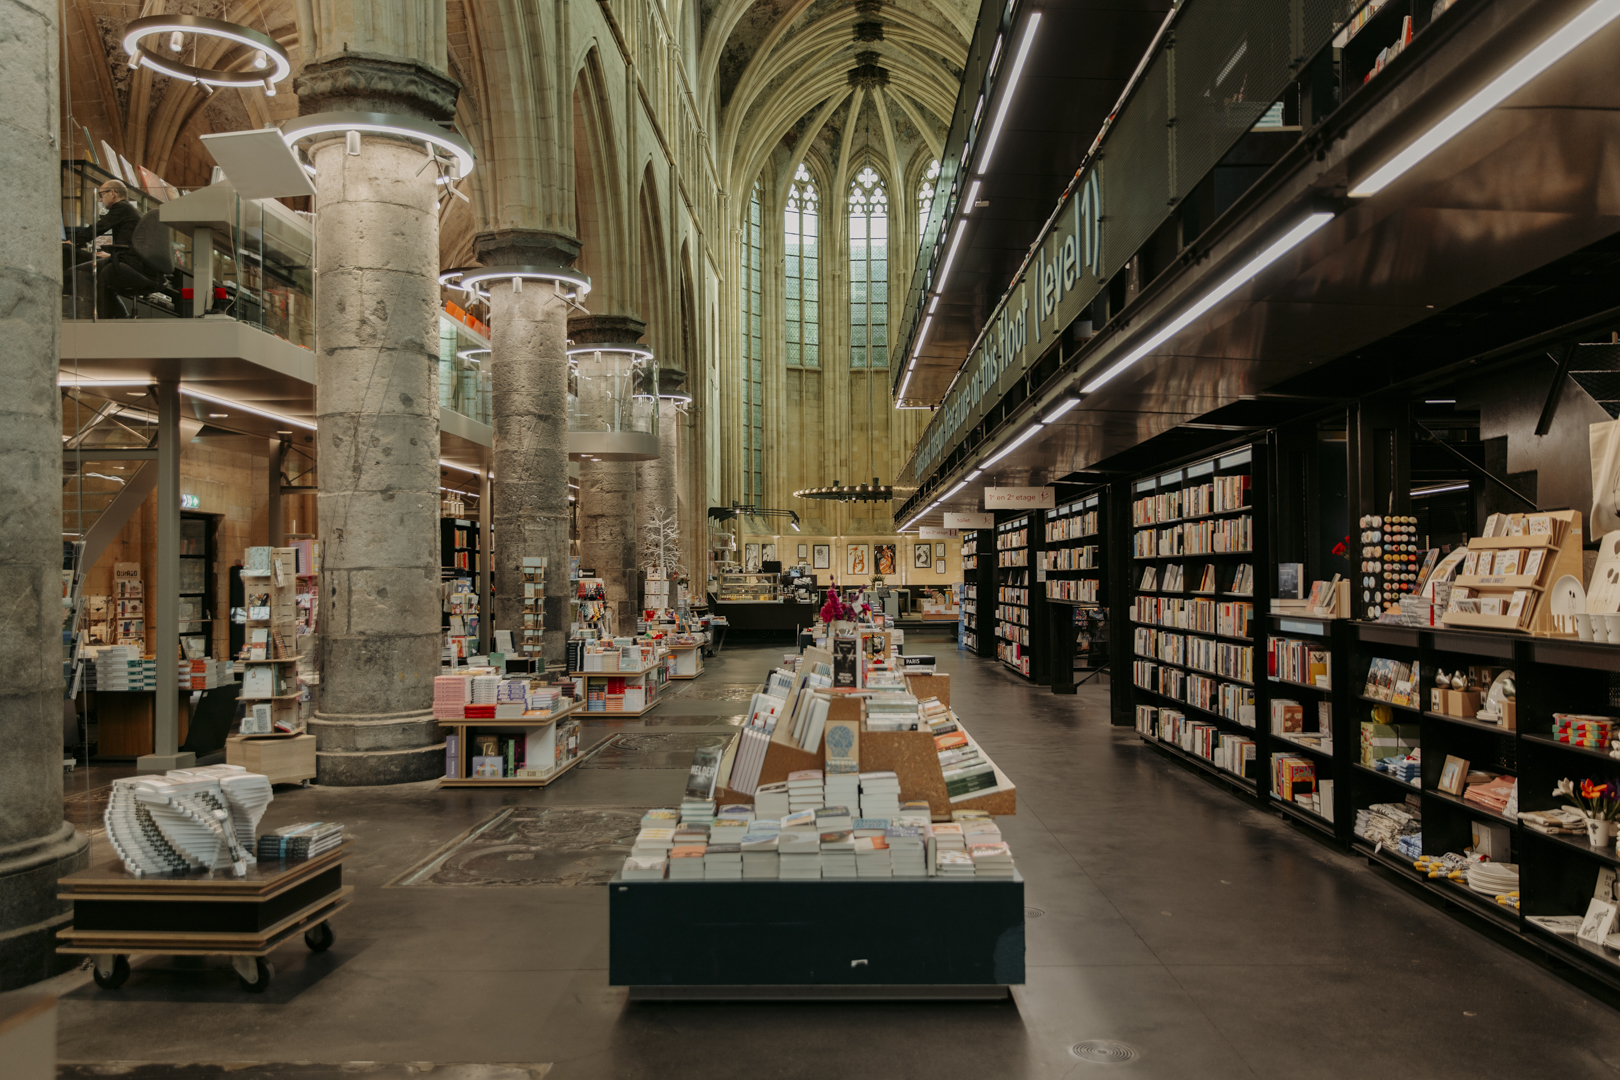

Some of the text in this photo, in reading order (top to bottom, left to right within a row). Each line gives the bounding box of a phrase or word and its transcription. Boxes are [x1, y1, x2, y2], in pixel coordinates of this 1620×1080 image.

[971, 370, 980, 409] on
[982, 334, 998, 396] this
[1001, 298, 1029, 372] floor
[1015, 494, 1036, 502] etage
[690, 765, 715, 777] HELDER
[1292, 766, 1315, 778] ECHO
